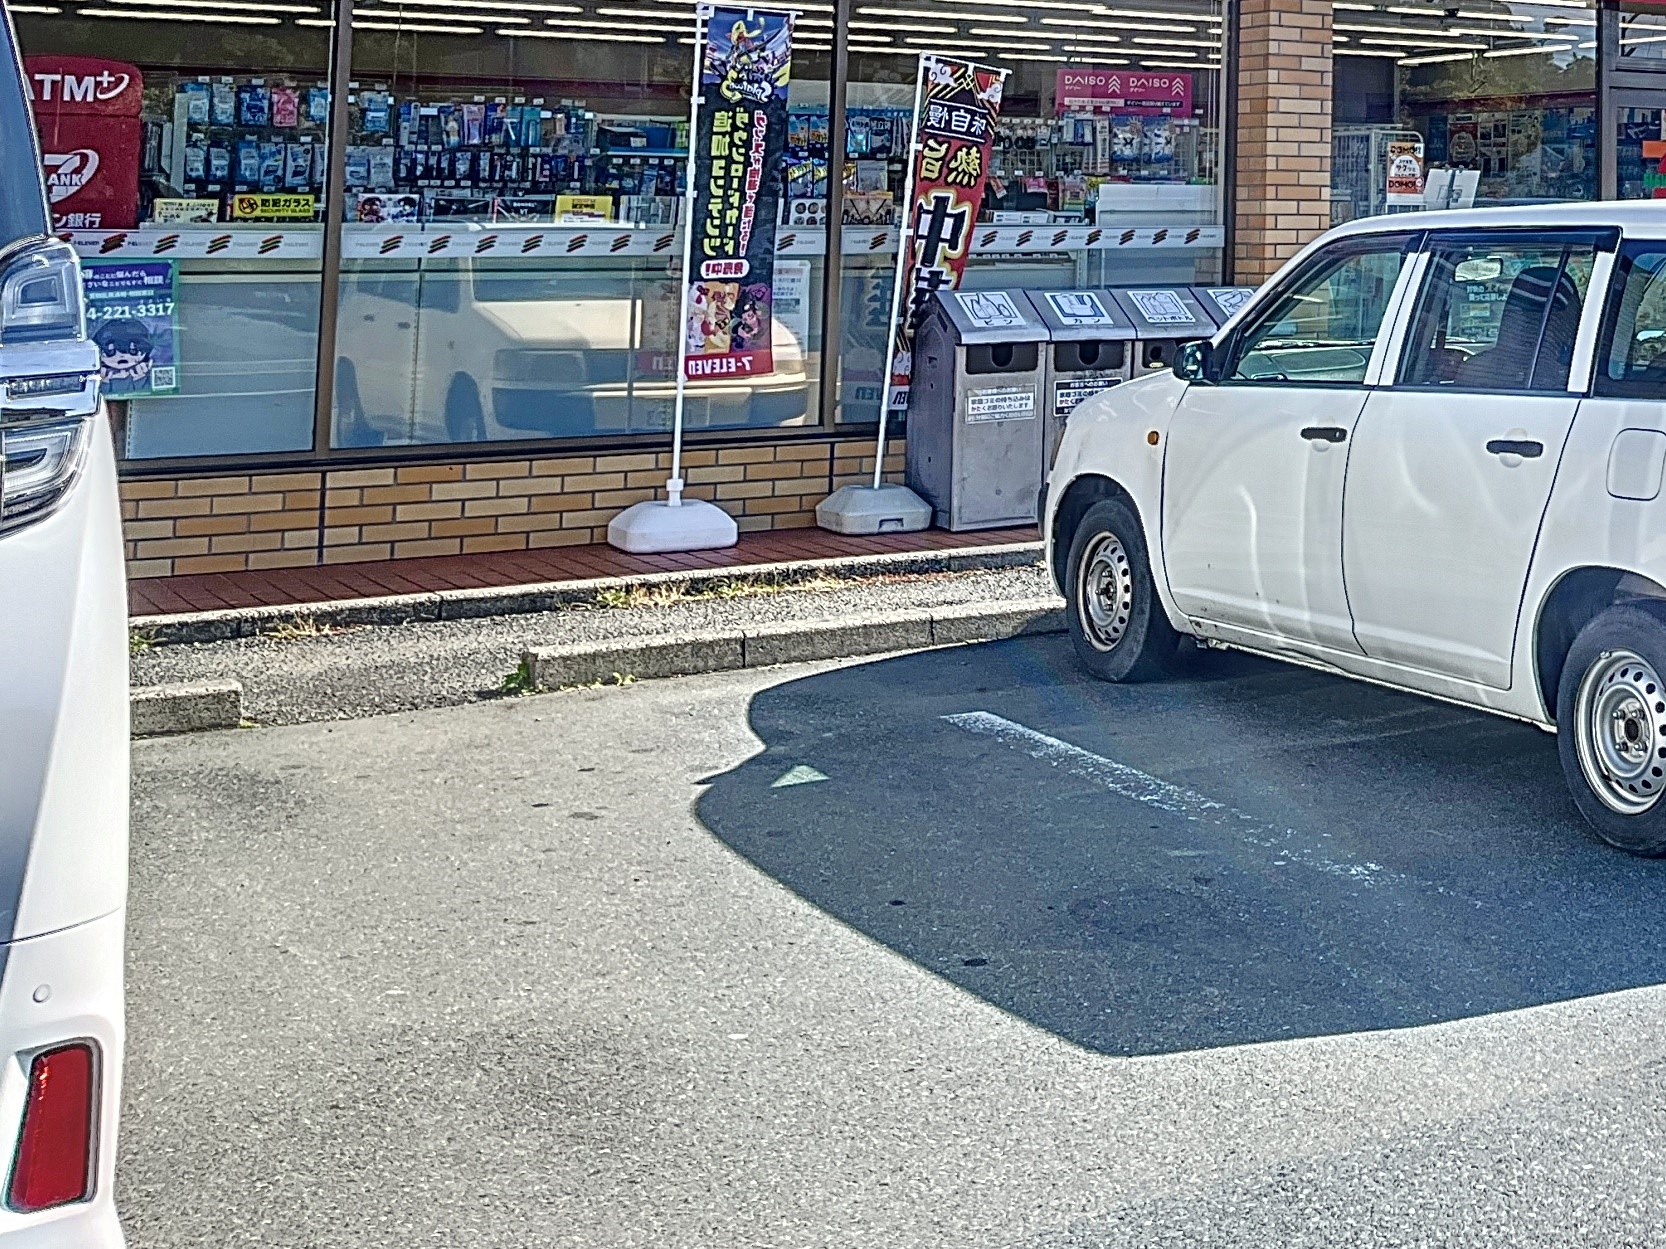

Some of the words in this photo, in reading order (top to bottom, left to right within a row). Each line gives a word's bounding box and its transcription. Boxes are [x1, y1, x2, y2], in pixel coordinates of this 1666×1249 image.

[1064, 75, 1106, 86] DAISO
[1129, 77, 1170, 88] DAISO
[47, 172, 84, 186] ANK
[1073, 317, 1101, 325] カン
